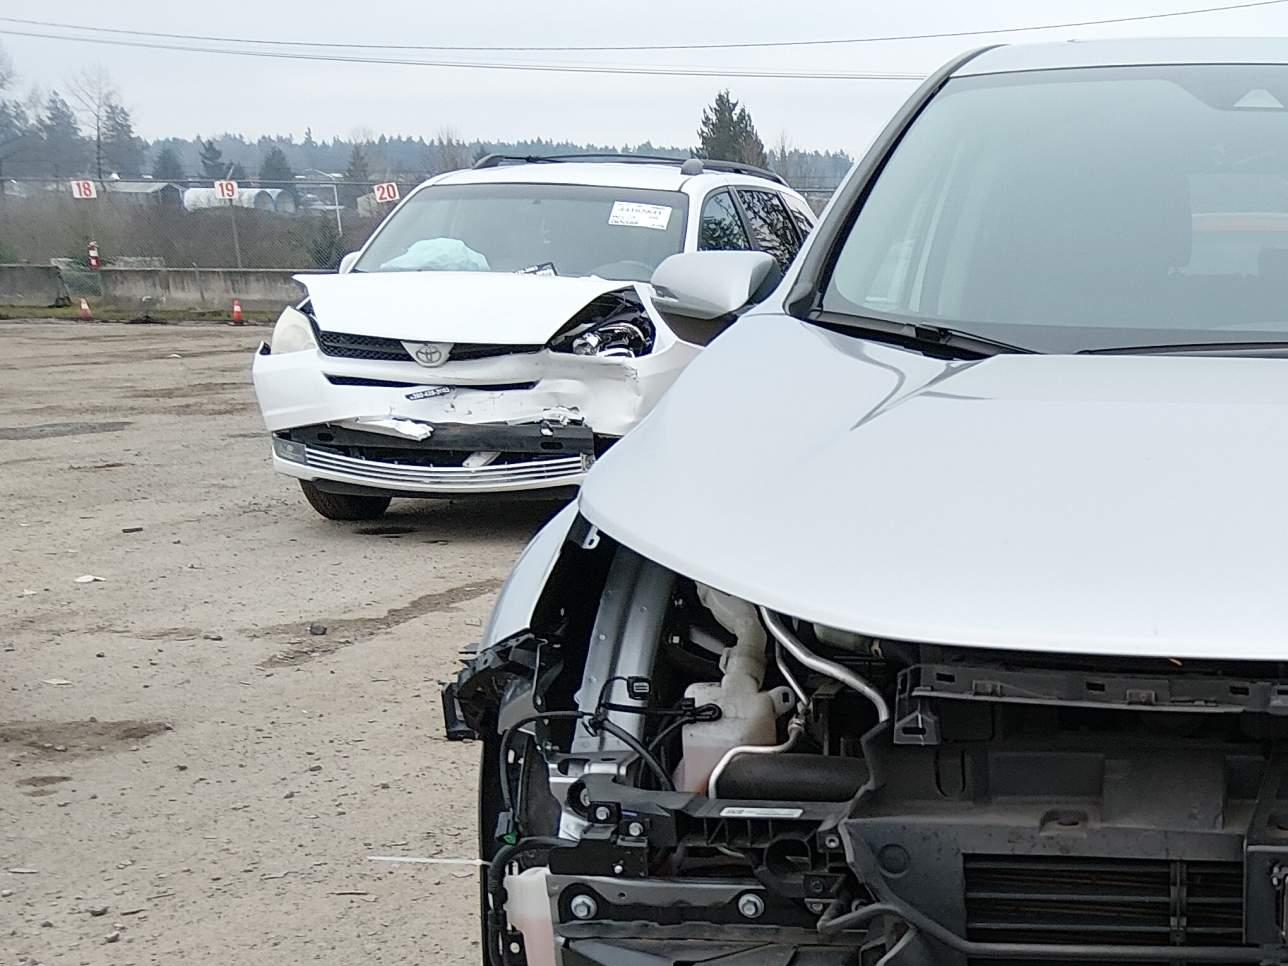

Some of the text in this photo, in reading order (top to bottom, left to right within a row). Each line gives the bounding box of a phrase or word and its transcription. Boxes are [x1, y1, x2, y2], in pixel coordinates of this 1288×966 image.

[76, 182, 92, 197] 18
[219, 182, 235, 197] 19
[376, 183, 397, 201] 20
